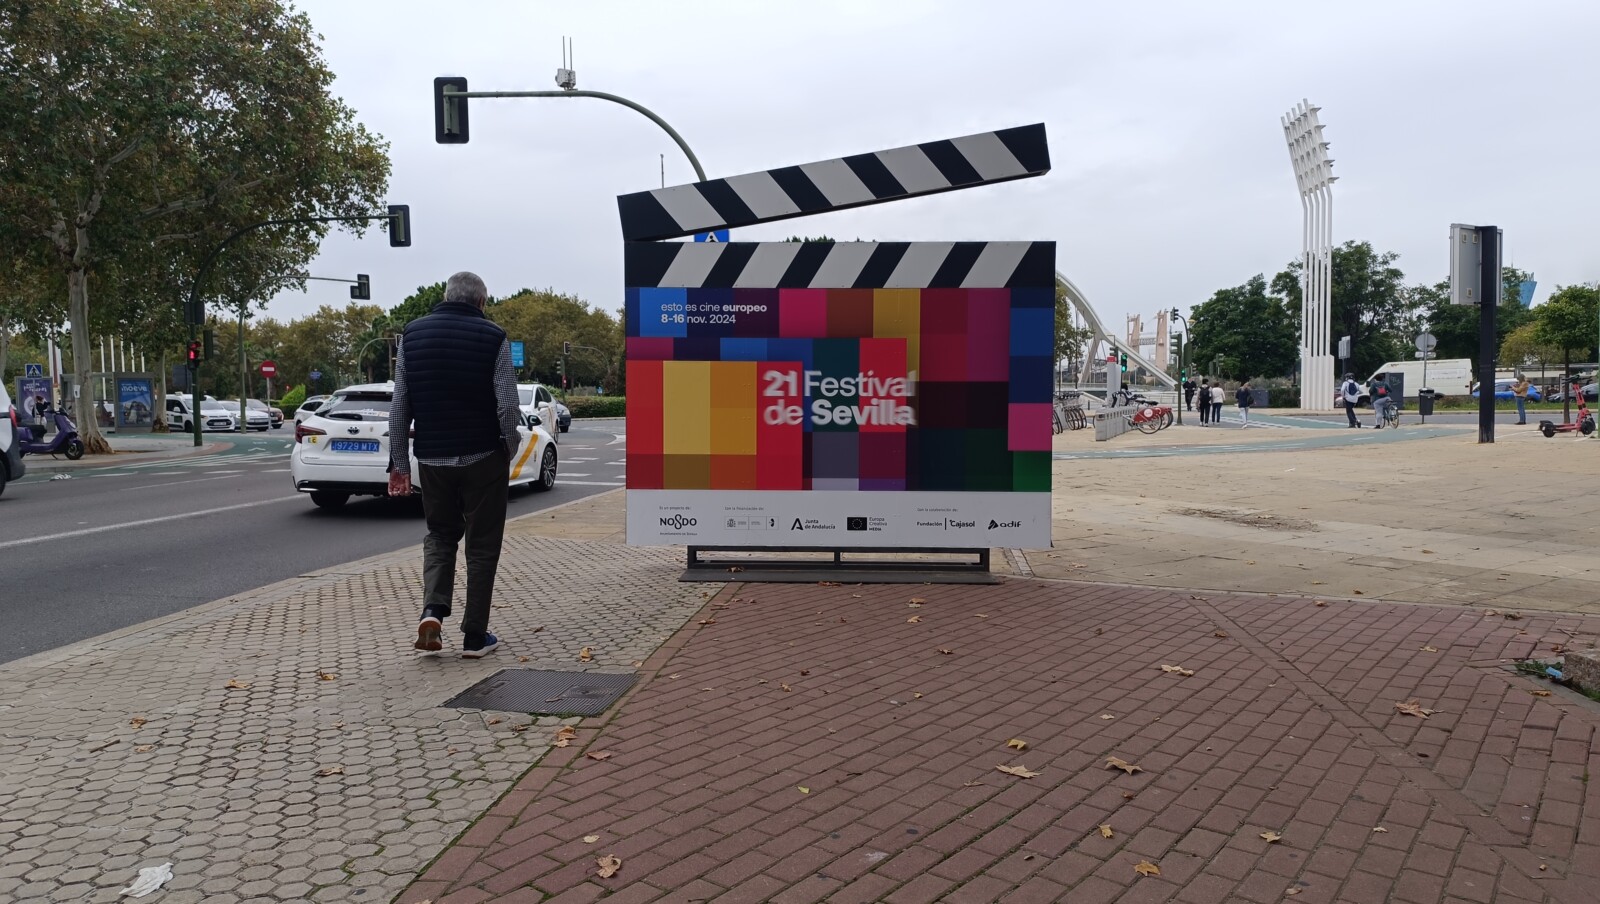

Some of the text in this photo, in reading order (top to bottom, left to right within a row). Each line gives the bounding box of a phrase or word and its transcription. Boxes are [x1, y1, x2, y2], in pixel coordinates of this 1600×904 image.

[661, 302, 767, 314] esto es cine europeo
[661, 314, 736, 324] 8-16 nov. 2024
[763, 370, 917, 397] 21 Festival
[763, 398, 917, 426] de Sevilla
[337, 442, 359, 451] 9729
[361, 443, 378, 451] MTX
[949, 520, 975, 528] Cajasol
